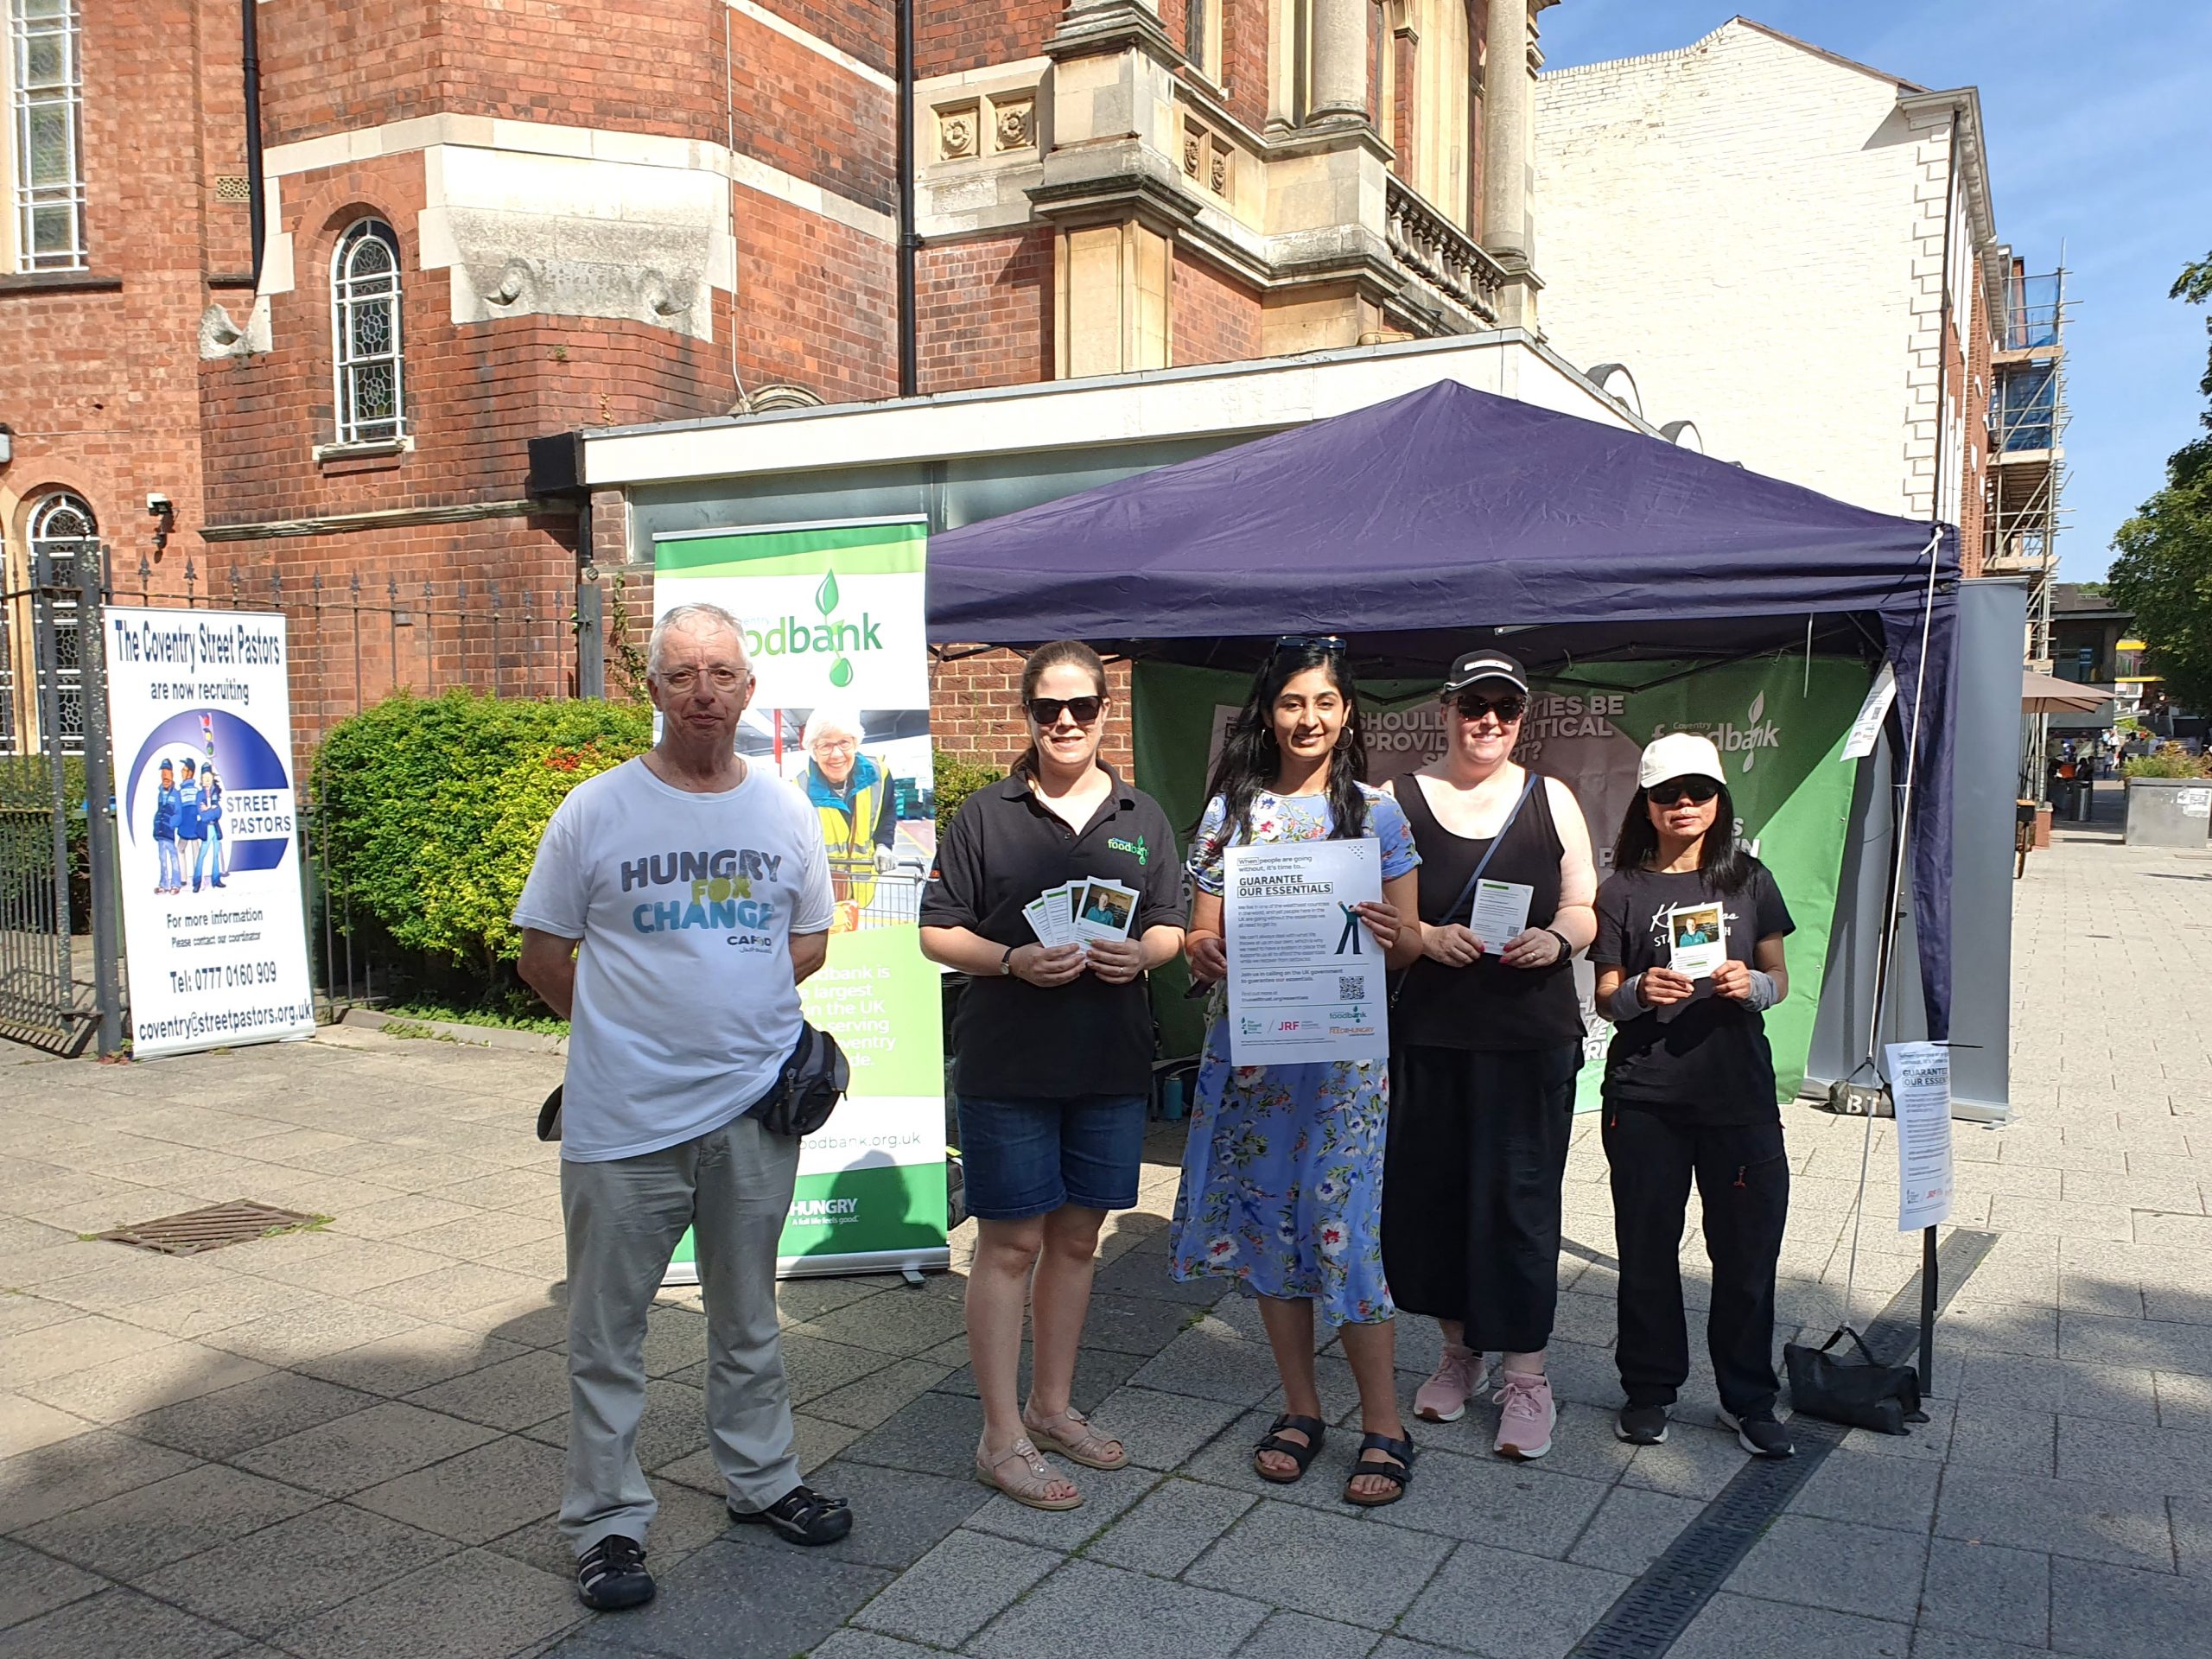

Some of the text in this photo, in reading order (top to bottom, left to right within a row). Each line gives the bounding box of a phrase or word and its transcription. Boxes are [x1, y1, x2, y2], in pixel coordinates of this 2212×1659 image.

[745, 612, 883, 657] oodbank
[115, 619, 280, 674] The Coventry Street Pastors
[150, 678, 249, 706] are now recruiting
[1591, 695, 1624, 715] BE
[1363, 716, 1614, 752] PROVID RITICAL
[1673, 721, 1712, 732] Coventry
[1652, 720, 1780, 752] fdbank
[226, 795, 278, 813] STREET
[231, 816, 291, 834] PASTORS
[620, 849, 782, 893] HUNGRY
[1239, 874, 1304, 886] GUARANTEE
[691, 874, 752, 906] FOR
[1239, 884, 1331, 897] OUR ESSENTIALS
[167, 908, 264, 929] For more information
[632, 899, 775, 934] CHANGE
[171, 937, 192, 948] Please
[170, 961, 276, 993] Tel: 0777 0160 909
[877, 963, 890, 978] is
[815, 983, 872, 1001] largest
[826, 1001, 855, 1015] the
[860, 999, 885, 1014] UK
[139, 998, 312, 1040] coventry@streetpastors.org.uk
[826, 1018, 890, 1034] serving
[1278, 1020, 1300, 1031] JRF
[836, 1036, 896, 1052] oventry
[800, 1132, 921, 1150] oodbank.org.uk
[789, 1198, 858, 1217] HUNGRY
